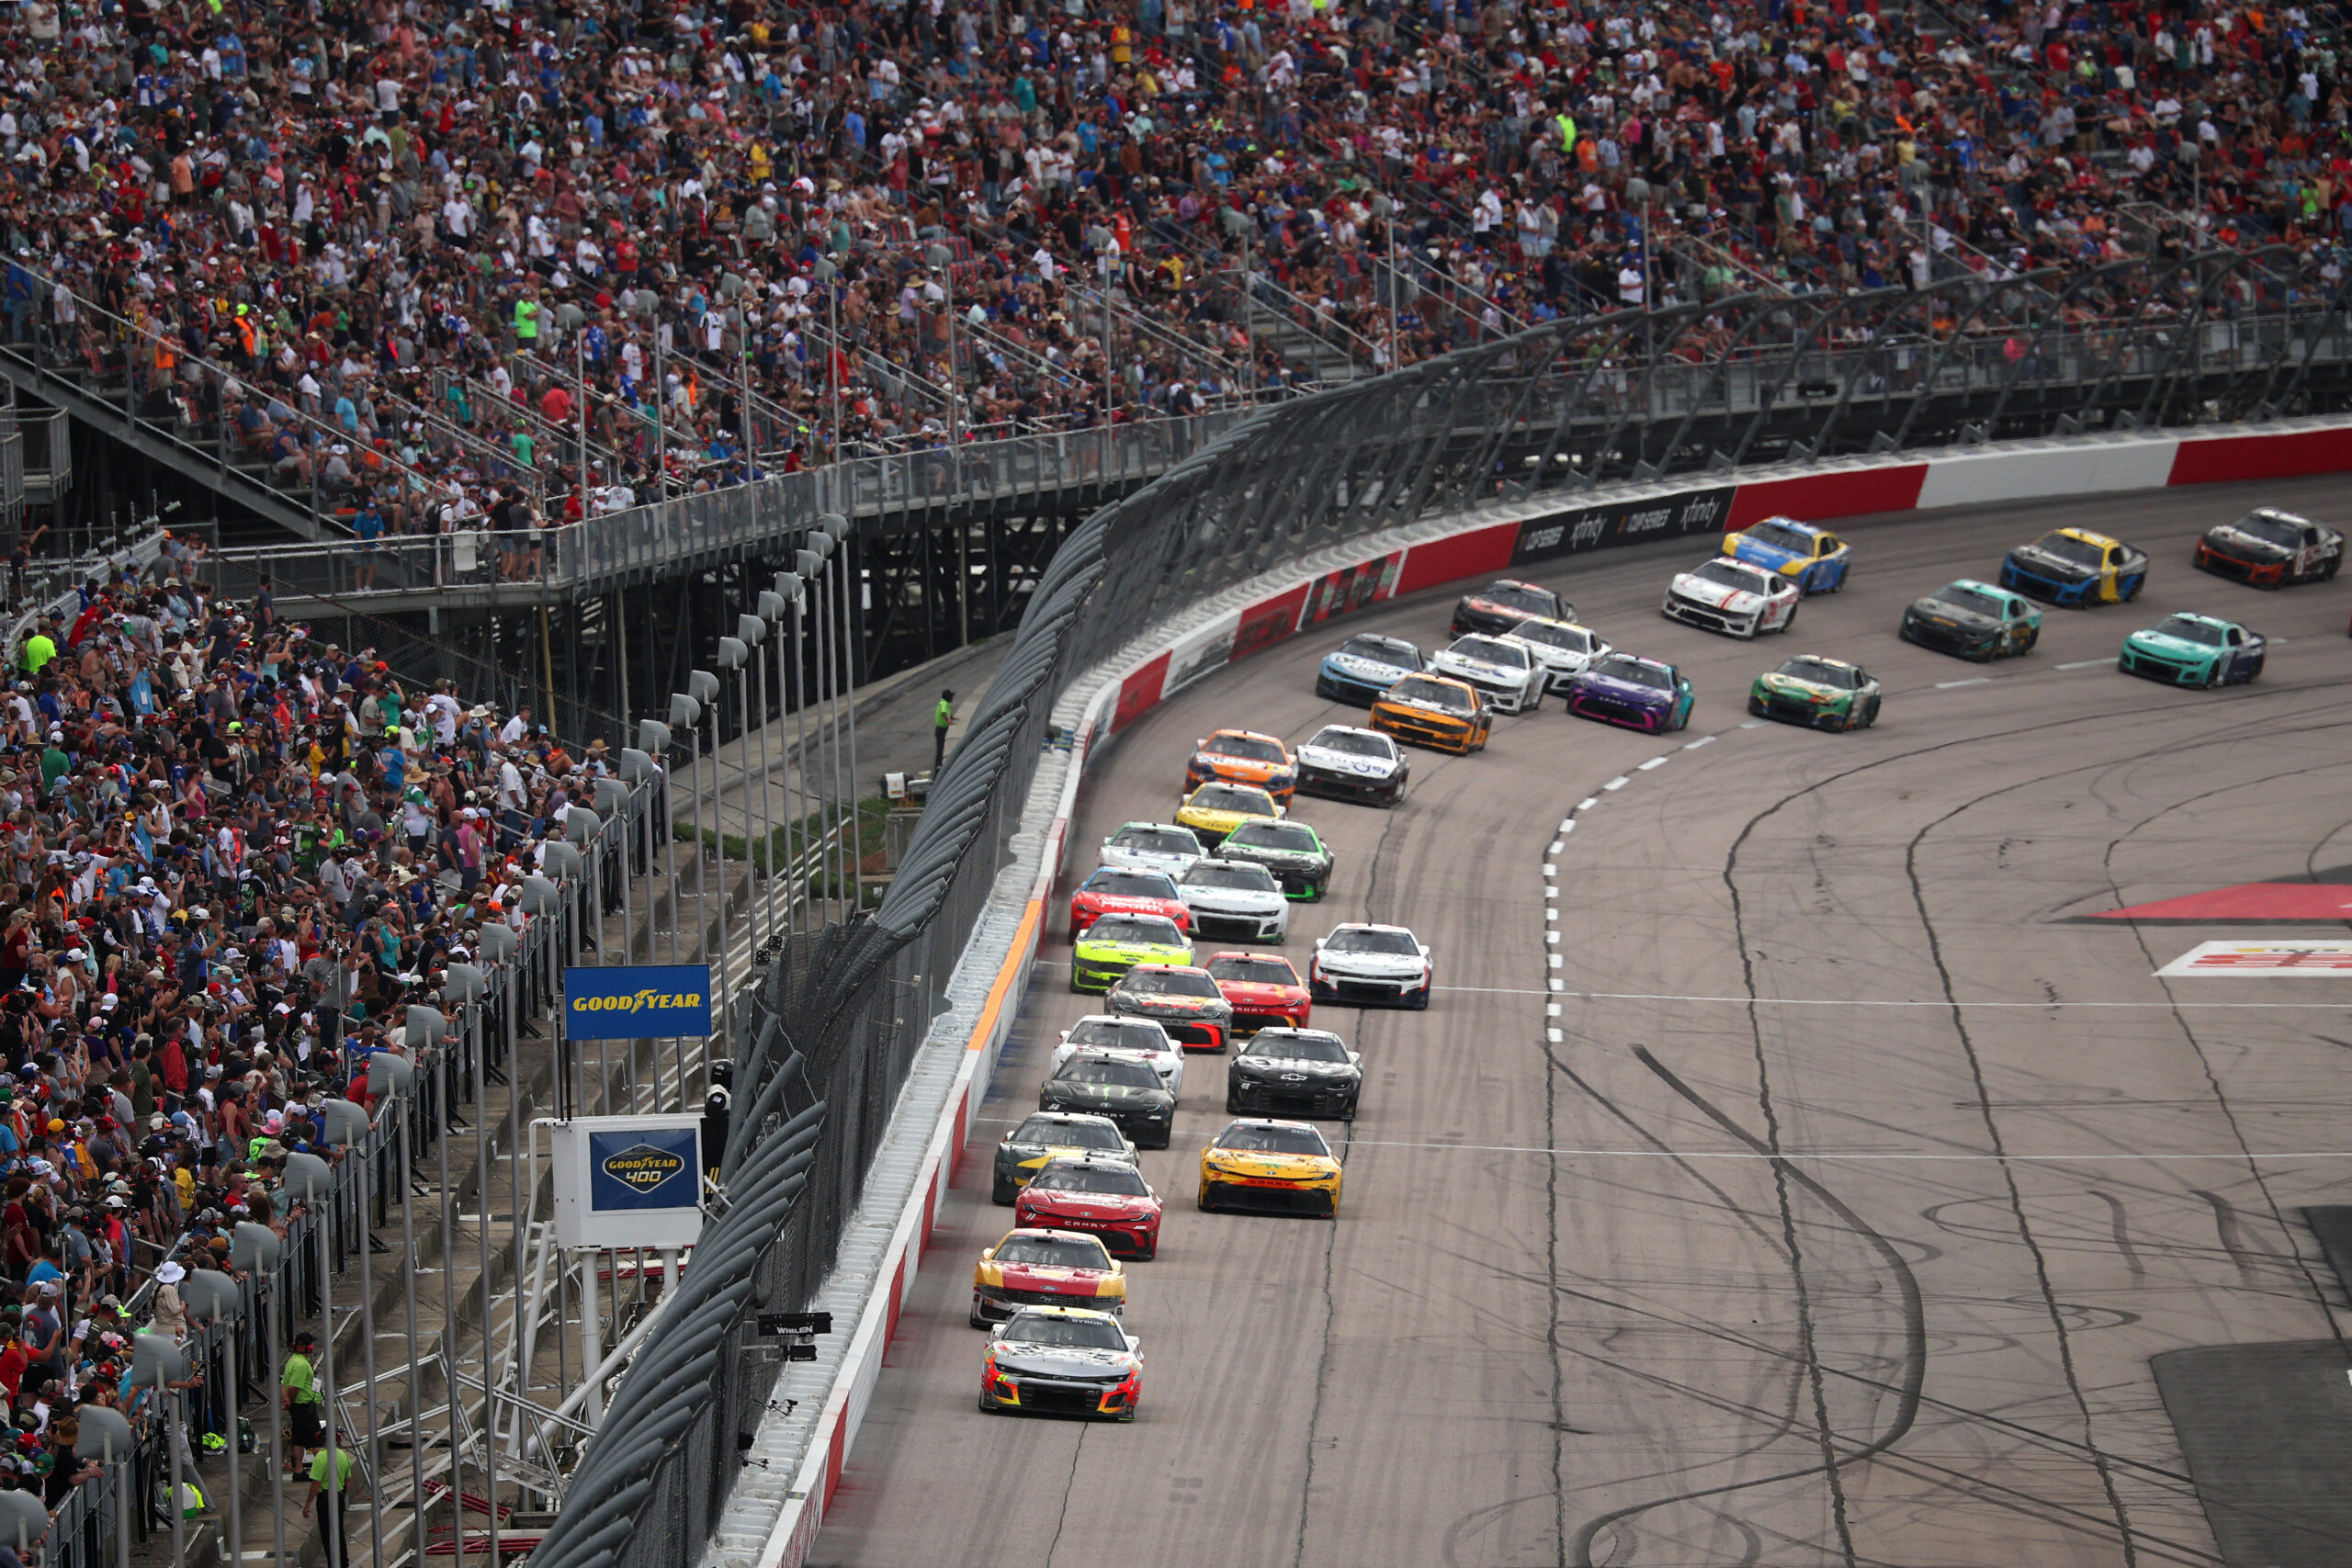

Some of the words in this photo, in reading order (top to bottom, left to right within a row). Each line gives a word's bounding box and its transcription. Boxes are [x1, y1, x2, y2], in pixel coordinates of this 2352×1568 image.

[1626, 512, 1647, 532] CUP
[1645, 508, 1671, 530] SERIES
[1679, 496, 1722, 531] xfinity
[1539, 525, 1565, 547] SERIES
[1569, 513, 1608, 548] xfinity
[608, 1157, 677, 1169] GOODYEAR
[626, 1170, 662, 1182] 400
[996, 1374, 1009, 1382] 24
